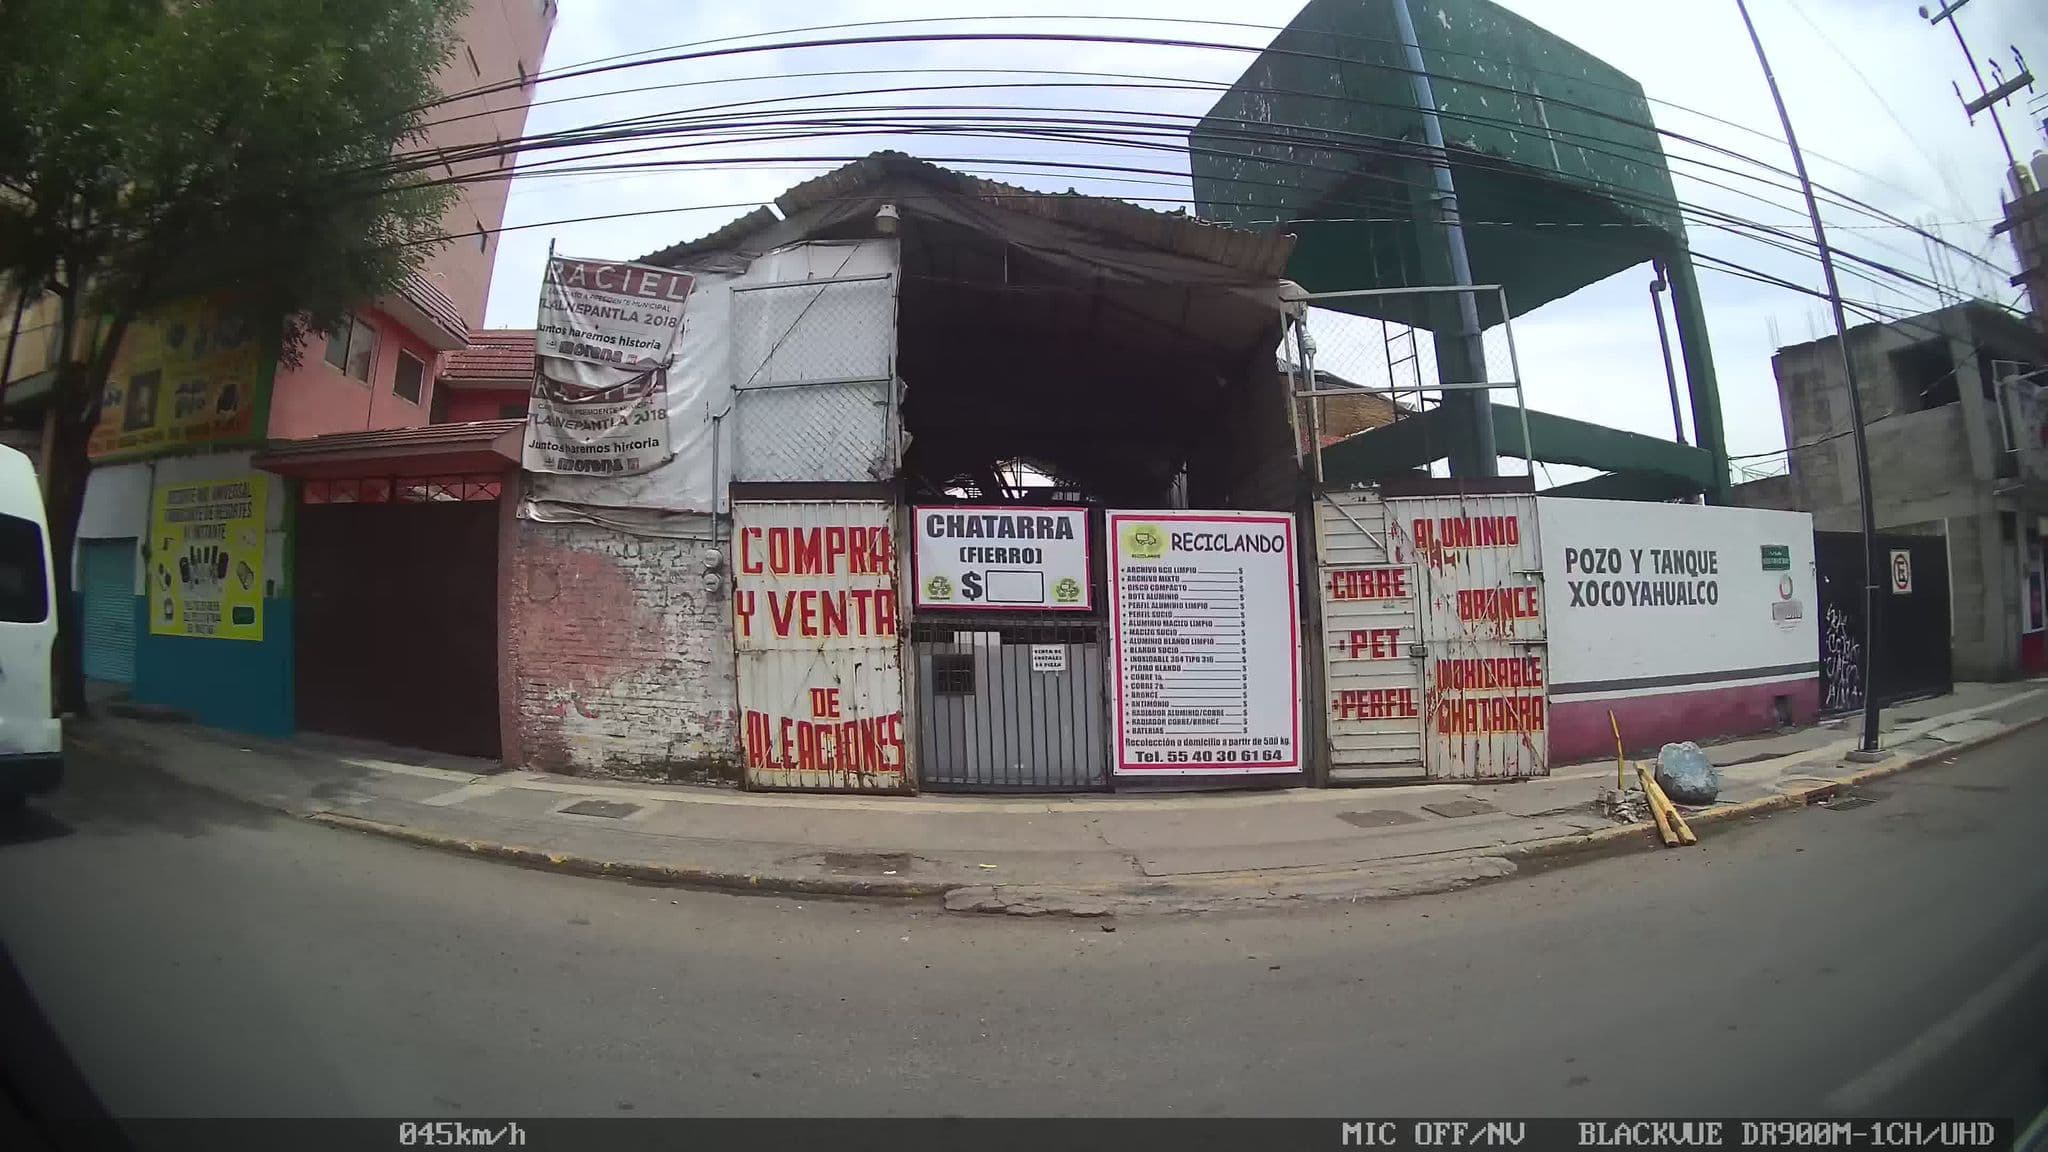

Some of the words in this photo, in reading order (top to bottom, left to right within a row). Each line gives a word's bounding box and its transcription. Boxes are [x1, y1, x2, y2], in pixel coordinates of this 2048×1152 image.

[547, 260, 684, 300] RACIEL
[539, 298, 639, 322] TLALNEPANTLA
[643, 314, 677, 328] 2018
[558, 340, 623, 363] morena
[568, 328, 616, 346] haremos
[618, 335, 662, 350] historia
[529, 412, 628, 431] TLANEPANTLA
[529, 439, 564, 453] Juntos
[557, 457, 624, 473] morena
[926, 514, 1074, 540] CHATARRA
[1413, 516, 1519, 549] ALUMINIO
[741, 526, 892, 575] COMPRA
[960, 546, 1042, 564] (FIERRO)
[1172, 532, 1284, 553] RECICLANDO
[1566, 548, 1622, 574] POZO
[1630, 549, 1644, 574] Y
[1650, 550, 1718, 577] TANQUE
[962, 570, 983, 601] $
[1332, 568, 1406, 599] COBRE
[1568, 580, 1719, 607] XOCOYAHUALCO
[736, 590, 754, 636] Y
[768, 589, 895, 637] VENTA
[1458, 586, 1539, 621] BRONCE
[1350, 630, 1400, 659] PET
[1436, 657, 1542, 690] INOXIDABLE
[810, 688, 840, 718] DE
[1341, 688, 1418, 719] PERFIL
[1438, 696, 1544, 734] CHATARRA
[746, 710, 905, 772] ALEACIONES
[1184, 737, 1220, 746] domicilio
[1229, 738, 1250, 748] partir
[1252, 737, 1262, 745] de
[1264, 737, 1278, 745] 500
[1135, 751, 1163, 762] Tel.
[1168, 751, 1188, 762] 55
[1192, 751, 1212, 761] 40
[1216, 751, 1237, 761] 30
[1241, 750, 1259, 761] 61
[1262, 750, 1282, 761] 64
